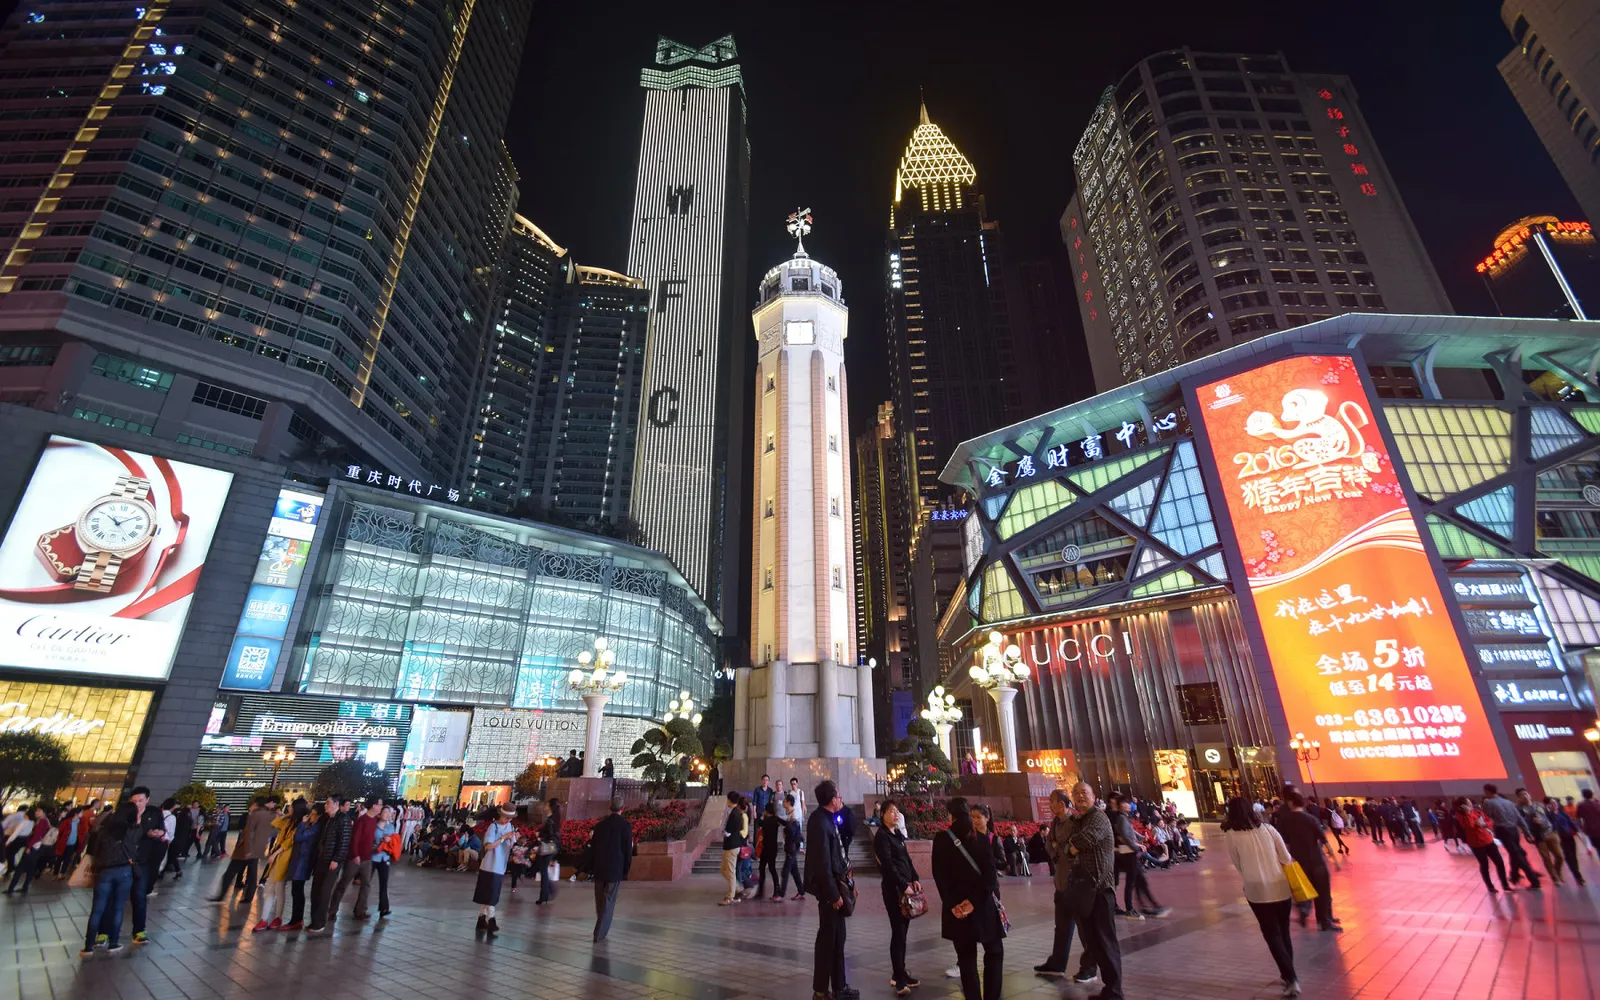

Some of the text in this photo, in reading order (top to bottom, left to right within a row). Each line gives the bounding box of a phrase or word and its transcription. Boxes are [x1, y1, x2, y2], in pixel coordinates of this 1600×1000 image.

[1557, 222, 1591, 231] ADBC
[985, 412, 1177, 487] 金鹰财富中心
[1233, 445, 1300, 479] 2016
[345, 465, 460, 502] 重庆时代广场
[1241, 465, 1372, 509] 猴年吉祥
[1262, 490, 1363, 514] Happy New Year
[16, 614, 131, 645] Cartier
[1315, 639, 1425, 675] 全场5折
[1329, 673, 1432, 696] 低至14元起
[261, 717, 397, 738] Ermenegildo Zegna
[484, 717, 579, 731] LOUIS VUITTON
[1514, 724, 1549, 740] MUJI
[1026, 757, 1067, 768] GUCCI
